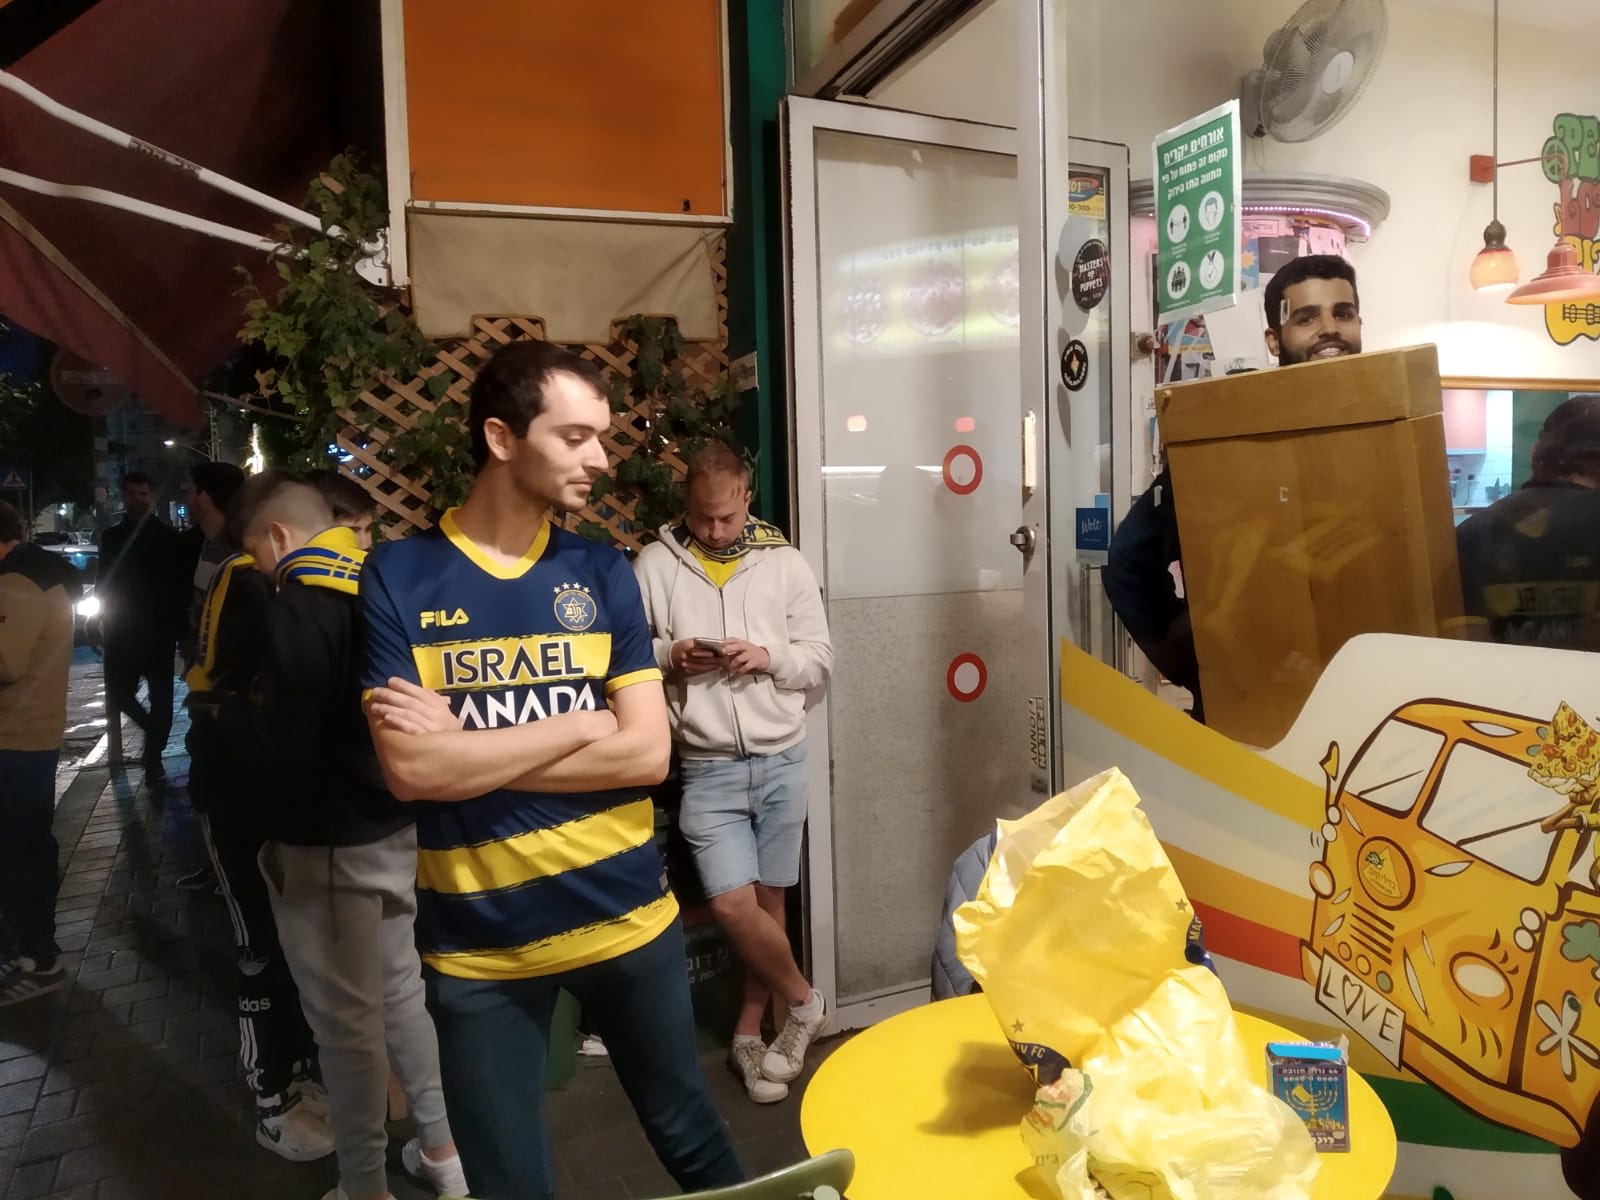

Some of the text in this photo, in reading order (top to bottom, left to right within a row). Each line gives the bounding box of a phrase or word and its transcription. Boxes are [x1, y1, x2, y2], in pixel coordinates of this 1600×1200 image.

[1163, 126, 1224, 166] אורחים יקרים
[1198, 156, 1207, 168] זה
[1208, 147, 1228, 164] מקום
[1179, 160, 1197, 176] פתוח
[1079, 278, 1103, 293] PUPPETS
[420, 608, 470, 629] FILA
[442, 641, 585, 687] ISRAEL
[443, 681, 597, 730] ANADA
[238, 995, 272, 1013] idas
[1322, 966, 1400, 1043] LOVE
[1031, 1045, 1046, 1059] FC
